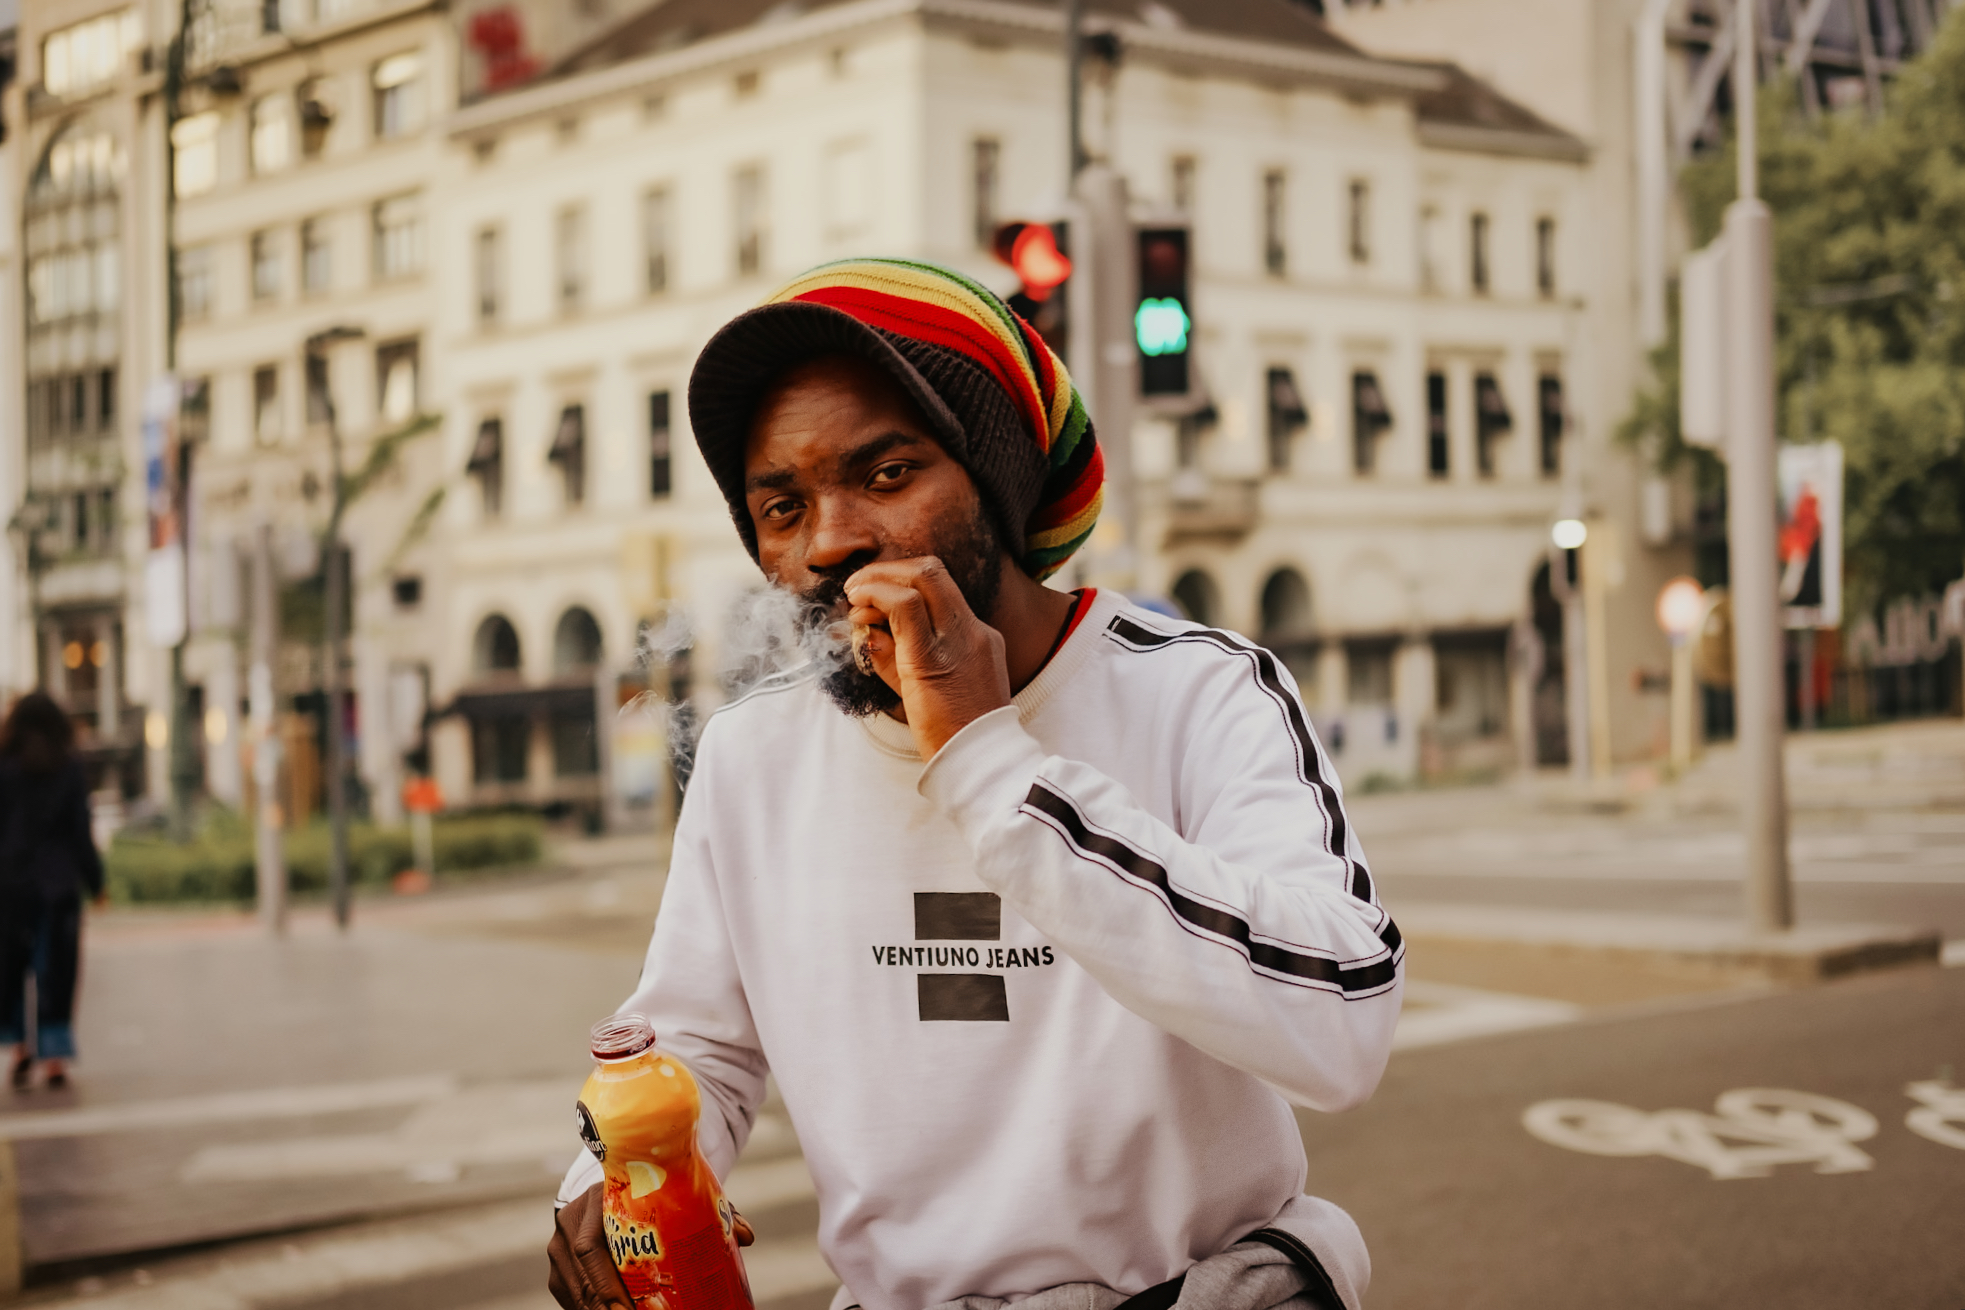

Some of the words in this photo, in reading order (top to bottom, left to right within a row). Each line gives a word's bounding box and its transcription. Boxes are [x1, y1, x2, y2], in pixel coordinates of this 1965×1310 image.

[872, 945, 980, 967] VENTIUNO
[986, 945, 1055, 969] JEANS
[607, 1226, 659, 1266] gria
